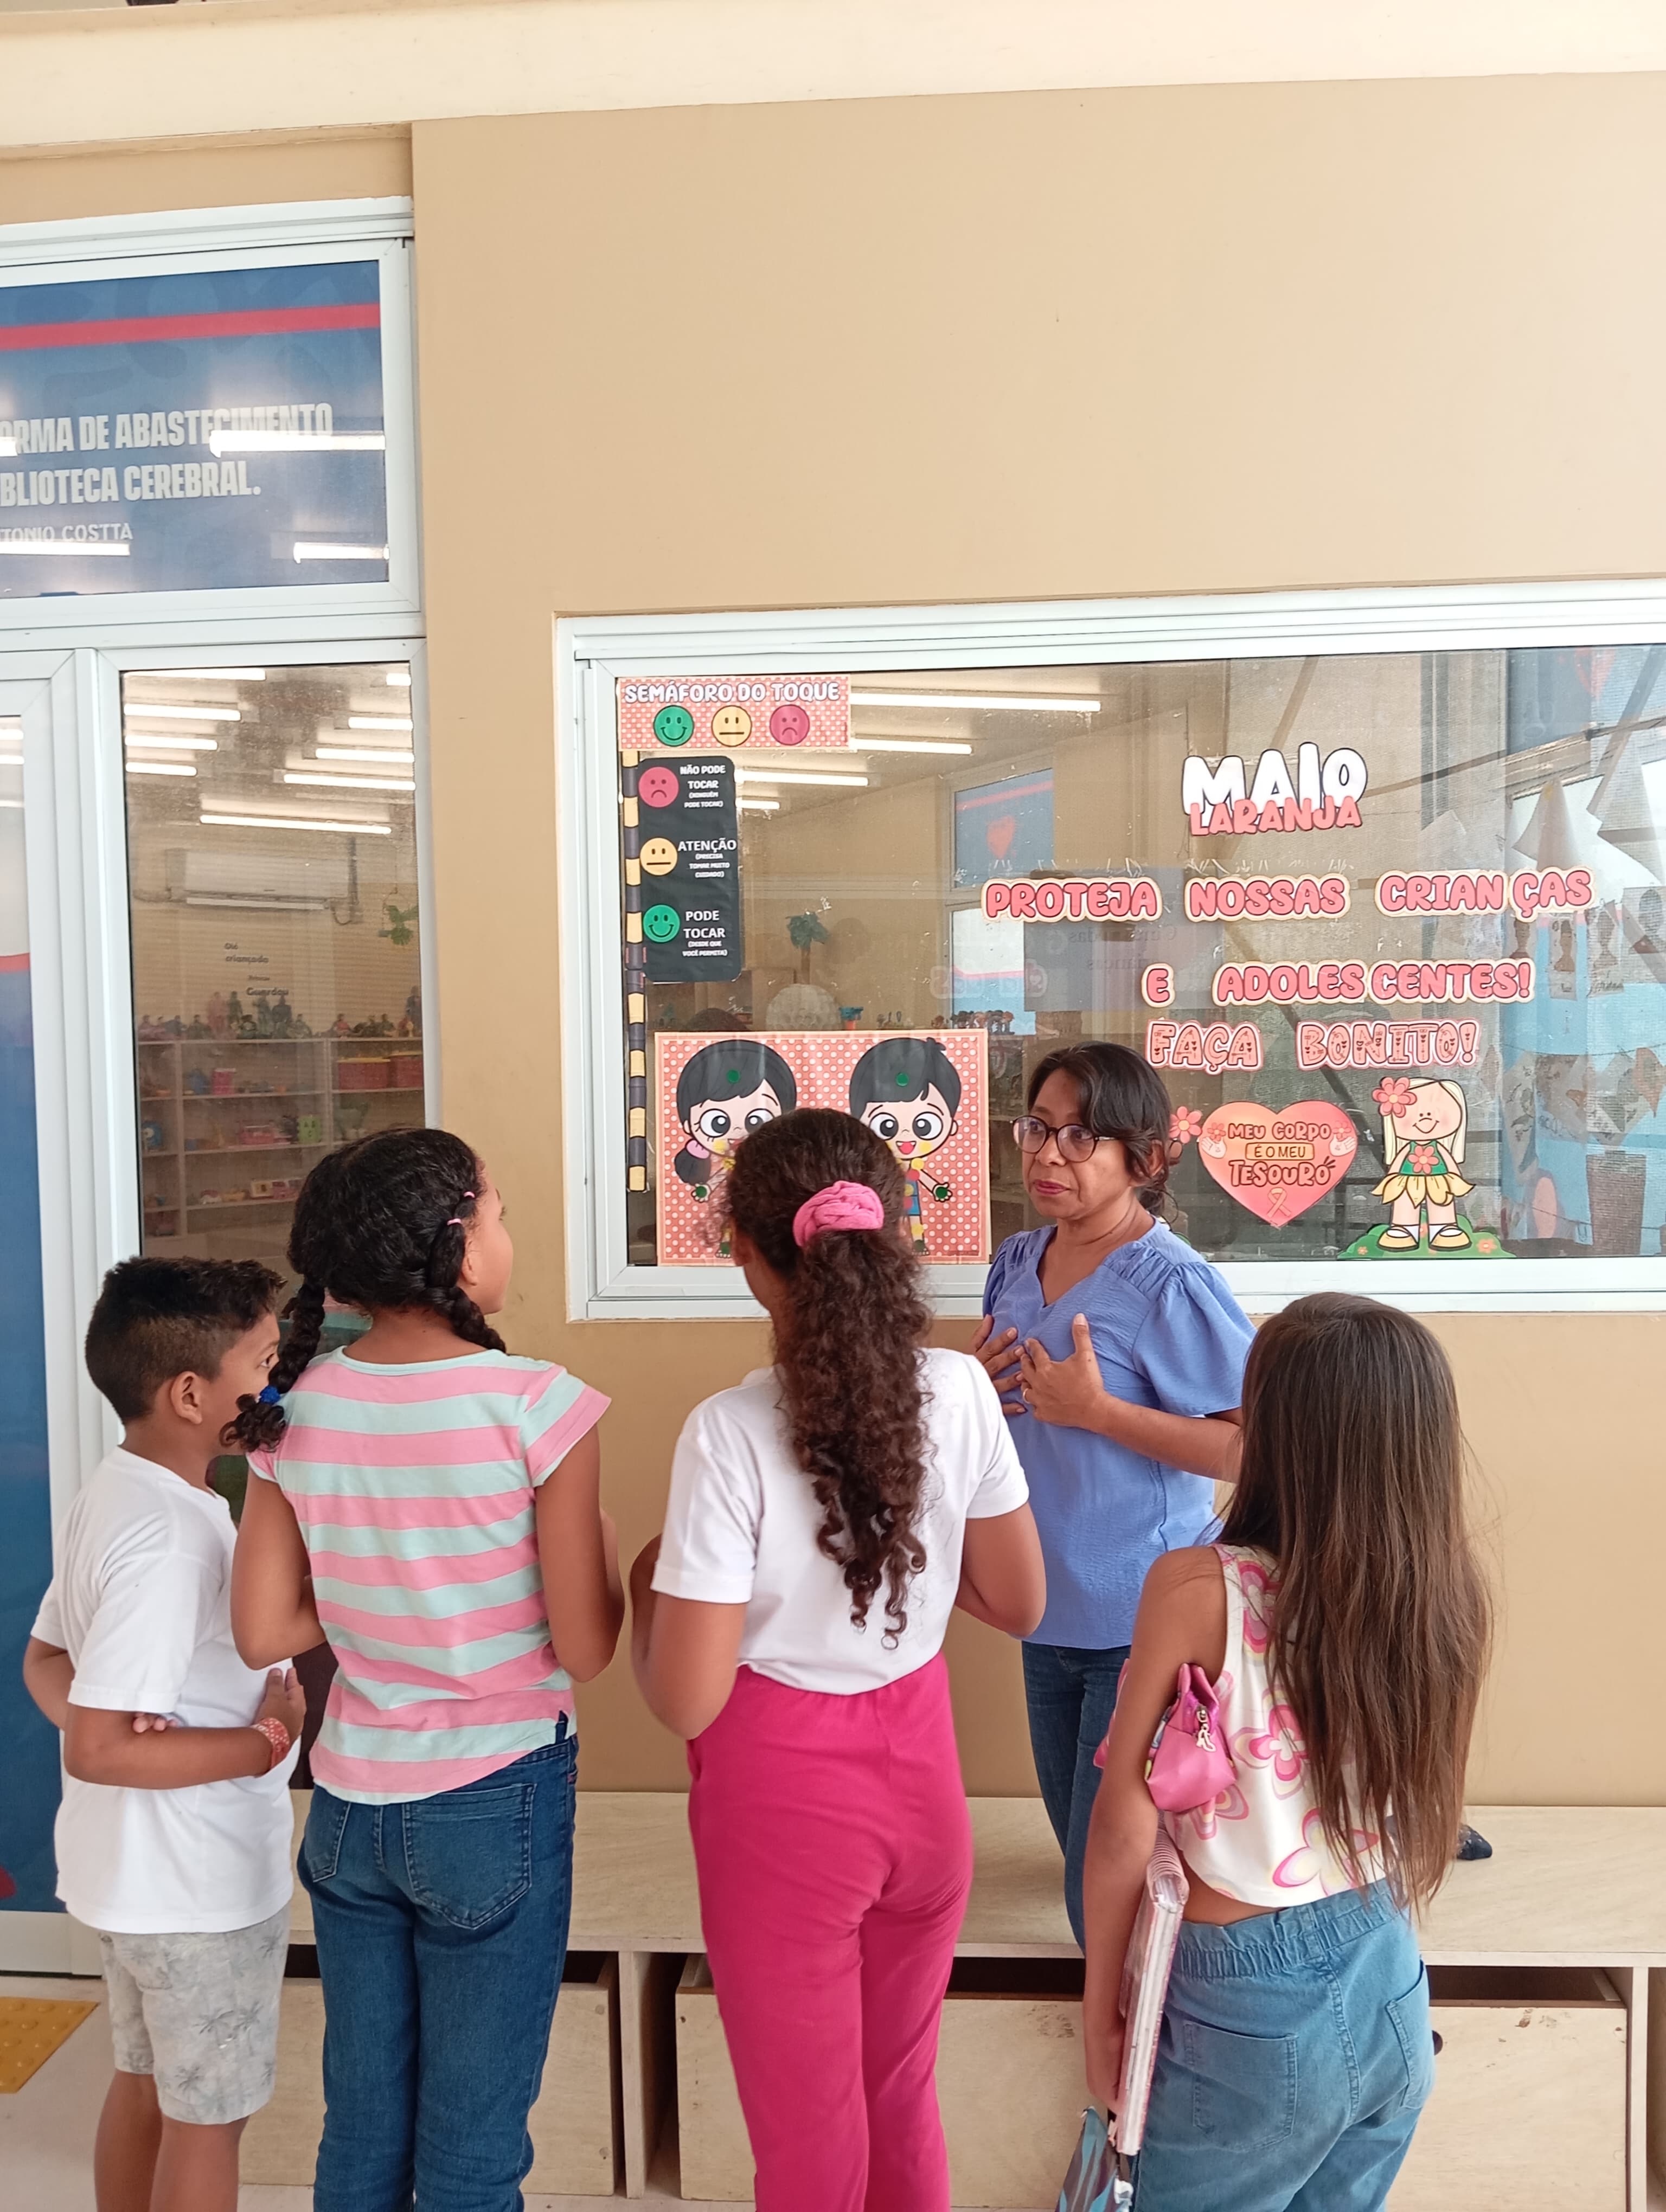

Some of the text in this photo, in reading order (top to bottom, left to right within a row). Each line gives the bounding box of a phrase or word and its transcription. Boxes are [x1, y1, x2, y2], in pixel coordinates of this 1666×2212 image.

[79, 415, 109, 451] DE
[115, 403, 332, 448] ABASTECIMENTO
[0, 461, 261, 507] BLIOTECA CEREBRAL.
[61, 522, 133, 542] COSTTA
[624, 681, 840, 703] SEMÁFORO DO TOQUE
[680, 764, 726, 775] NÃO PODE
[1182, 741, 1368, 815] MAIO
[687, 780, 719, 789] TOCAR
[1190, 795, 1363, 836] LARANJA
[677, 838, 737, 853] ATENÇÃO
[985, 880, 1158, 918] PROTEJA
[1189, 878, 1345, 916] NOSSAS
[685, 910, 720, 921] PODE
[683, 928, 726, 938] TOCAR
[1146, 968, 1171, 1002] E
[1149, 1021, 1477, 1073] FAÇA BONITO!
[1228, 1121, 1331, 1142] MEU CORPO
[1254, 1144, 1306, 1158] É O MEU
[1228, 1159, 1331, 1187] TESOURO
